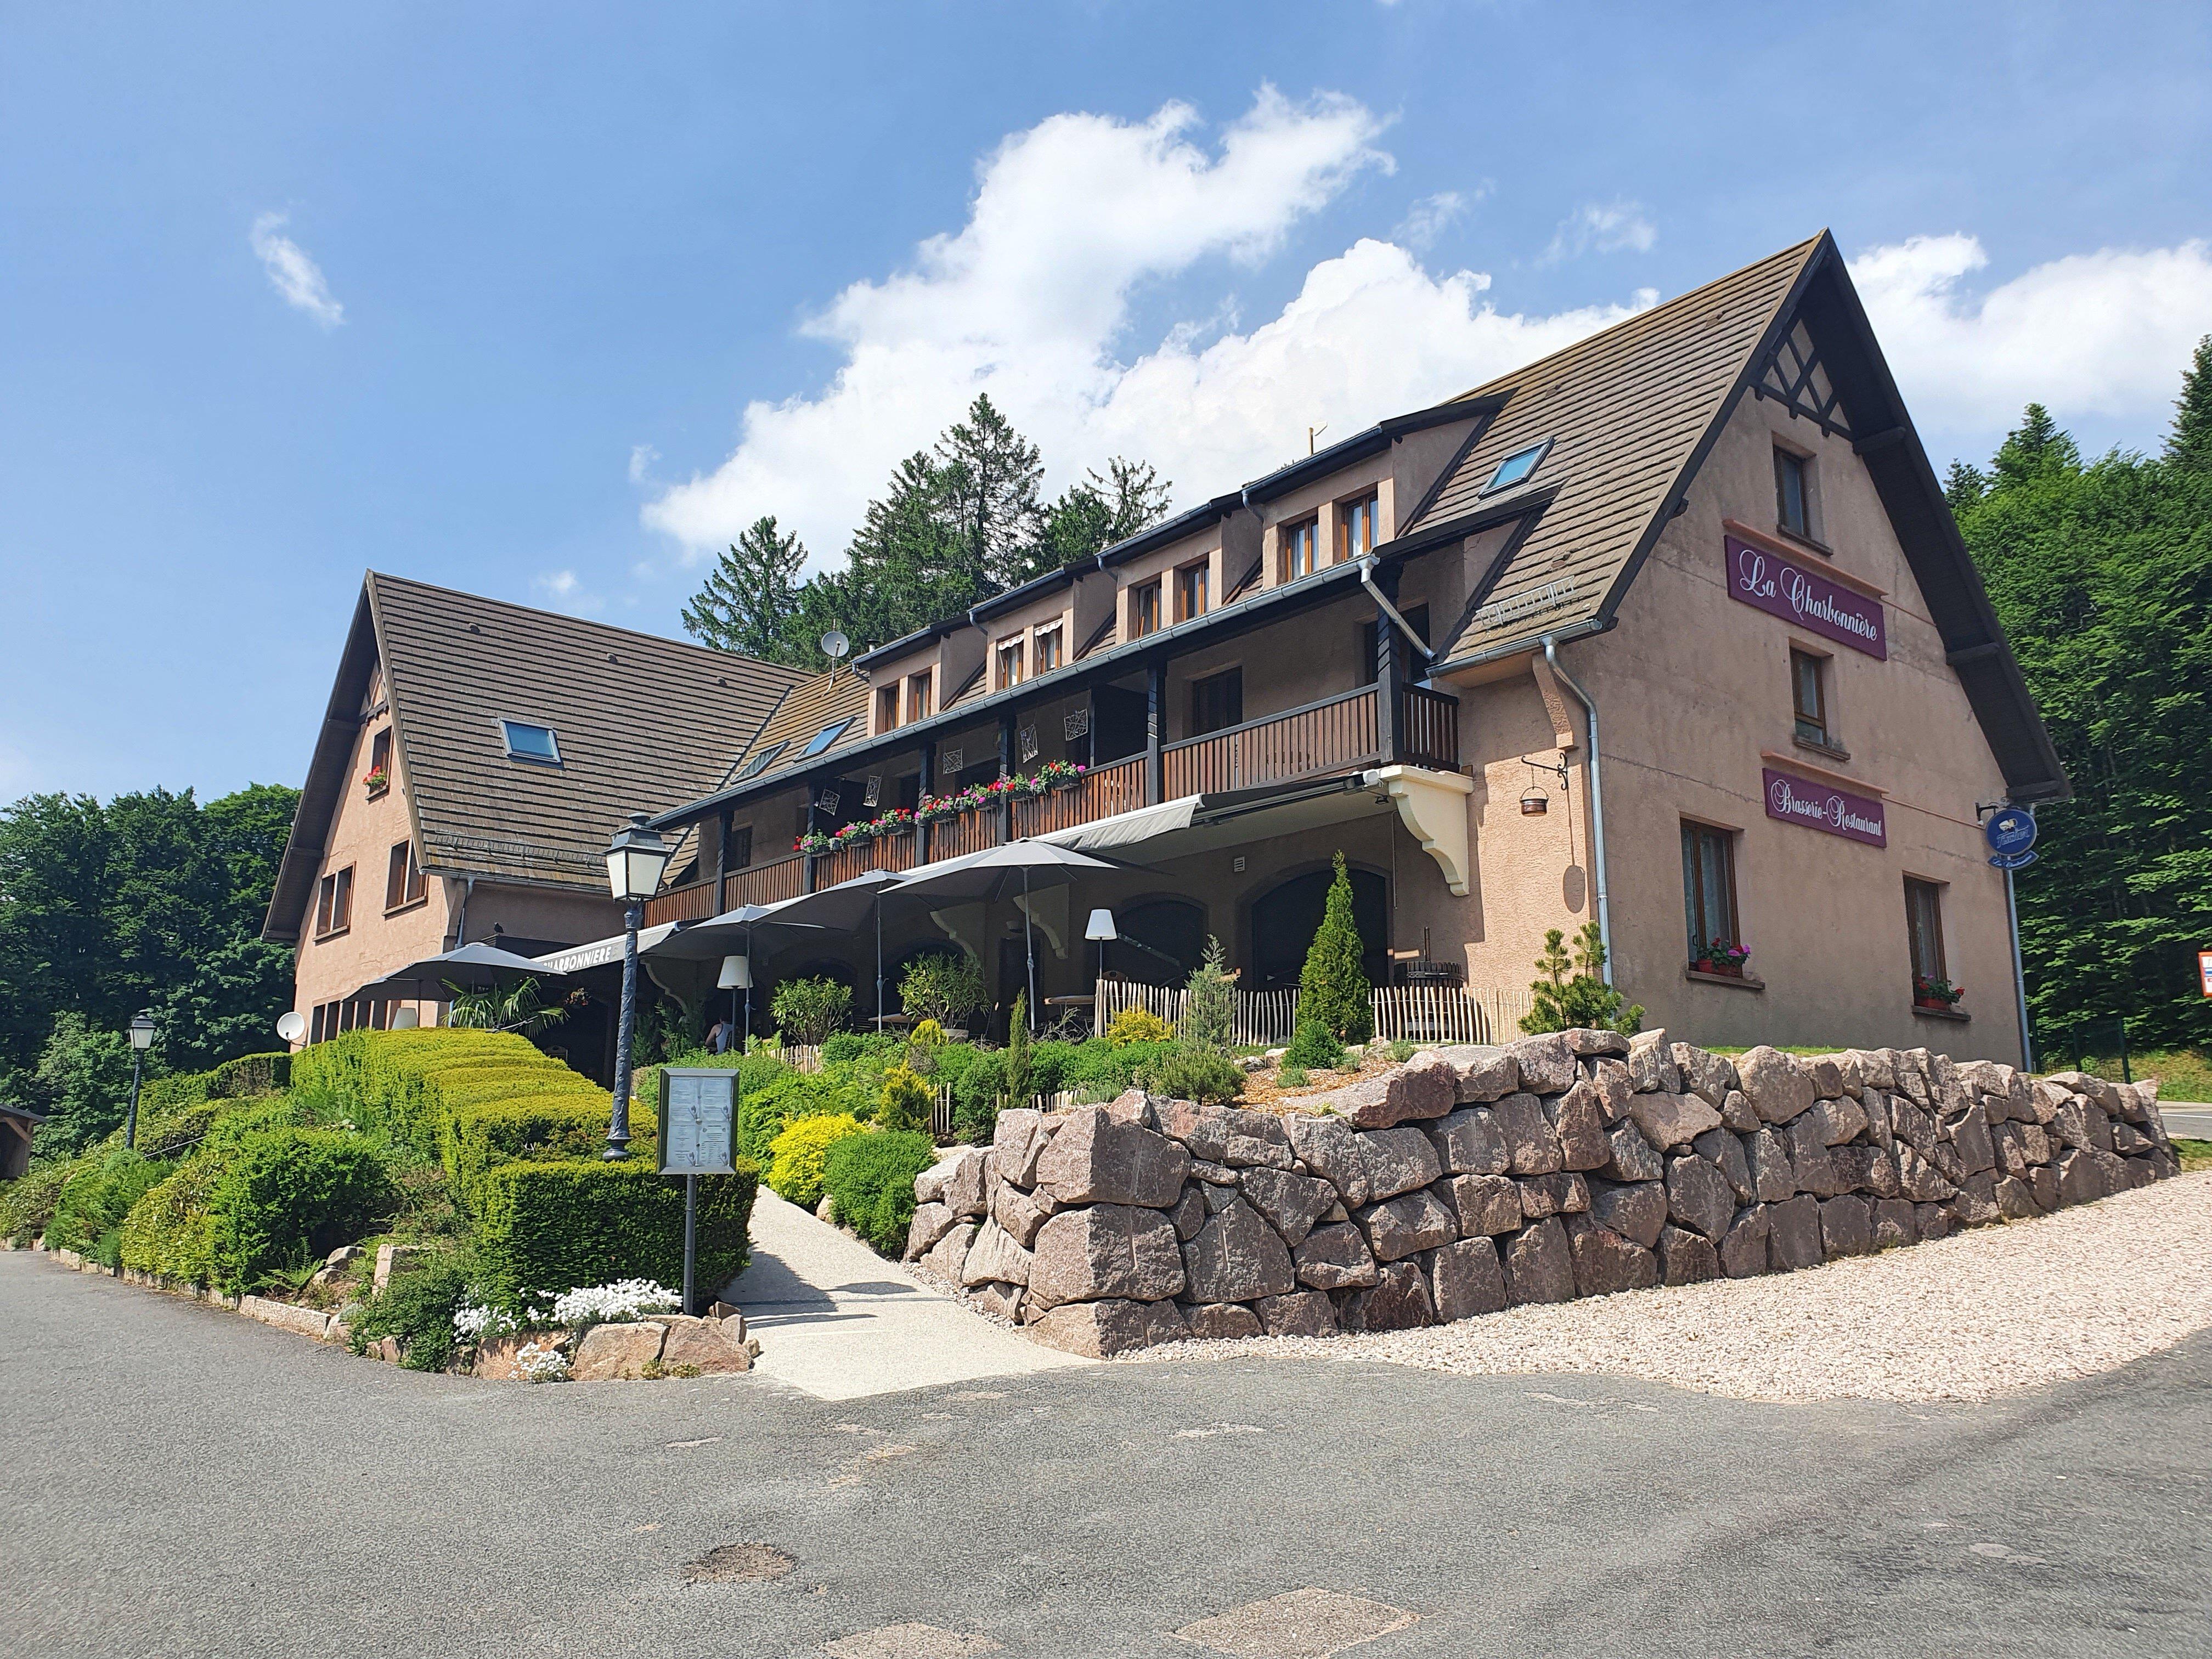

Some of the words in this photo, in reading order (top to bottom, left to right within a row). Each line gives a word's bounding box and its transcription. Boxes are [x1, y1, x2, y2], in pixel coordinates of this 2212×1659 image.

[1739, 549, 1776, 598] La
[1780, 567, 1877, 641] Charbonnière
[1770, 778, 1882, 837] Brasserie-Restaurant
[543, 946, 612, 972] ARBONNIERE
